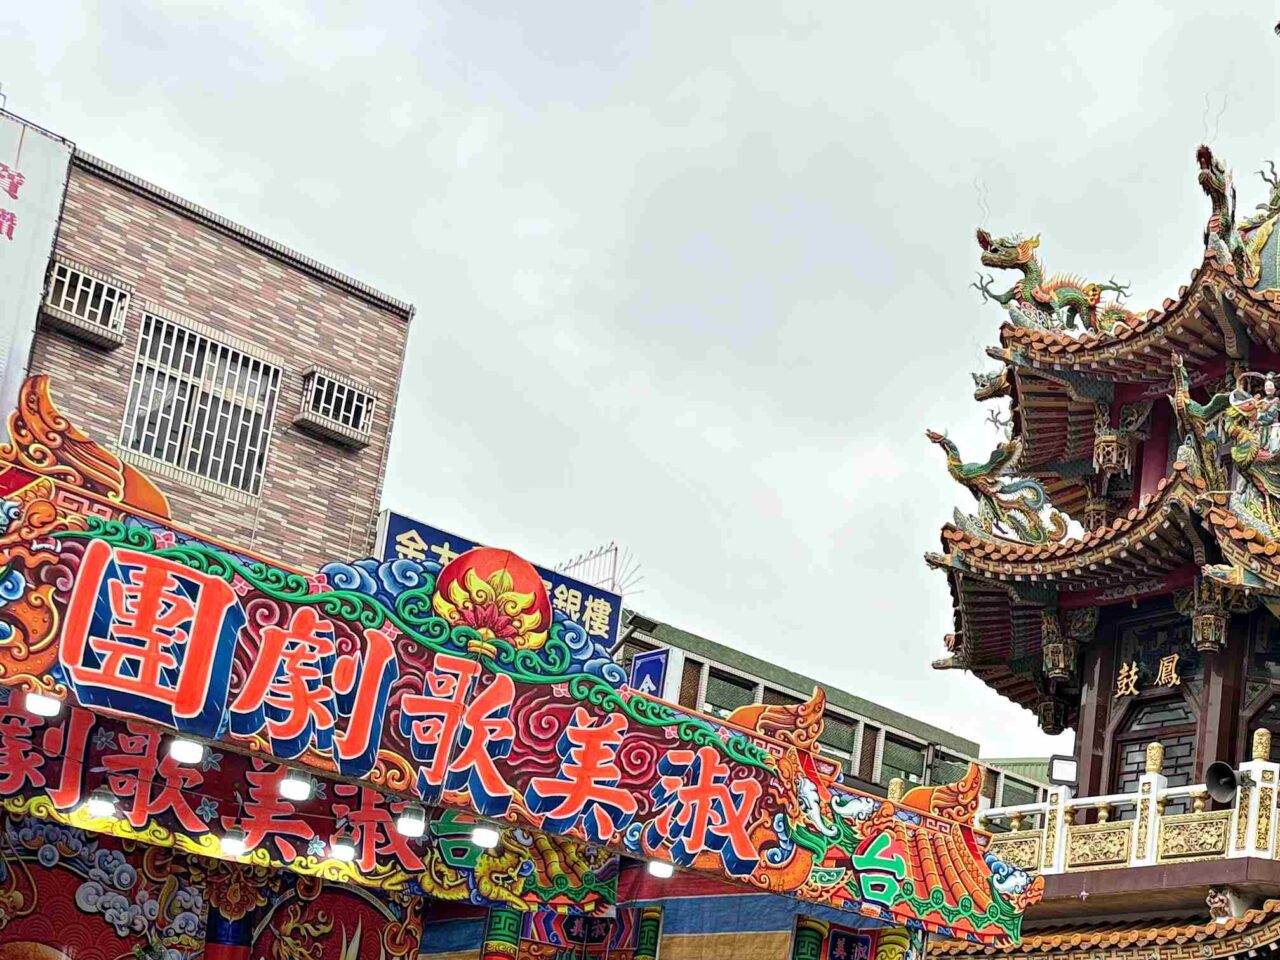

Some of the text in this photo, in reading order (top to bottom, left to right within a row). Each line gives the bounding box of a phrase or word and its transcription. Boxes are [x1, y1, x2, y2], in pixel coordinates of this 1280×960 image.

[60, 538, 766, 878] 淑美歌劇團
[1115, 653, 1181, 699] 鳳鼓
[852, 832, 906, 908] 台
